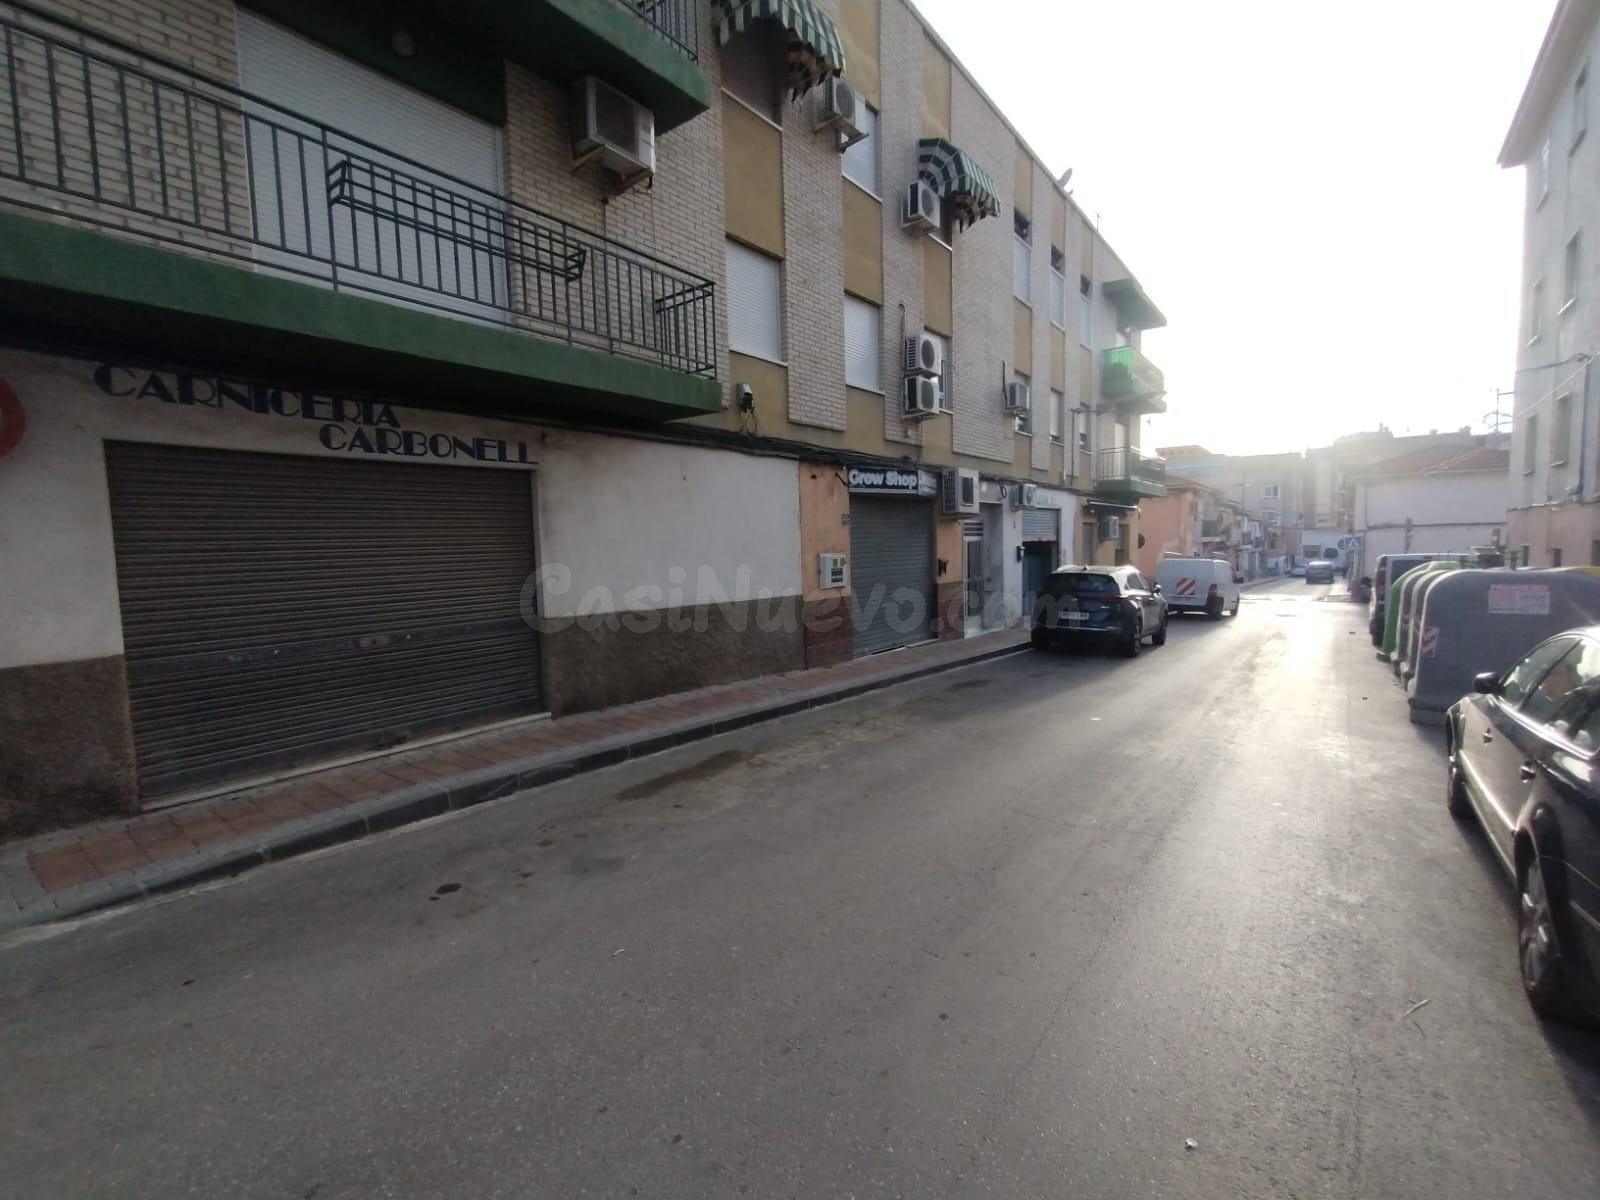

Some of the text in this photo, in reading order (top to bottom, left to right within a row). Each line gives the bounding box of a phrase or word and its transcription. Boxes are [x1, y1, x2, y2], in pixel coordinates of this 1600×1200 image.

[94, 363, 400, 427] CARNICERIA
[319, 423, 539, 465] CARBONELL
[848, 469, 885, 485] Grow
[885, 470, 917, 489] Shop
